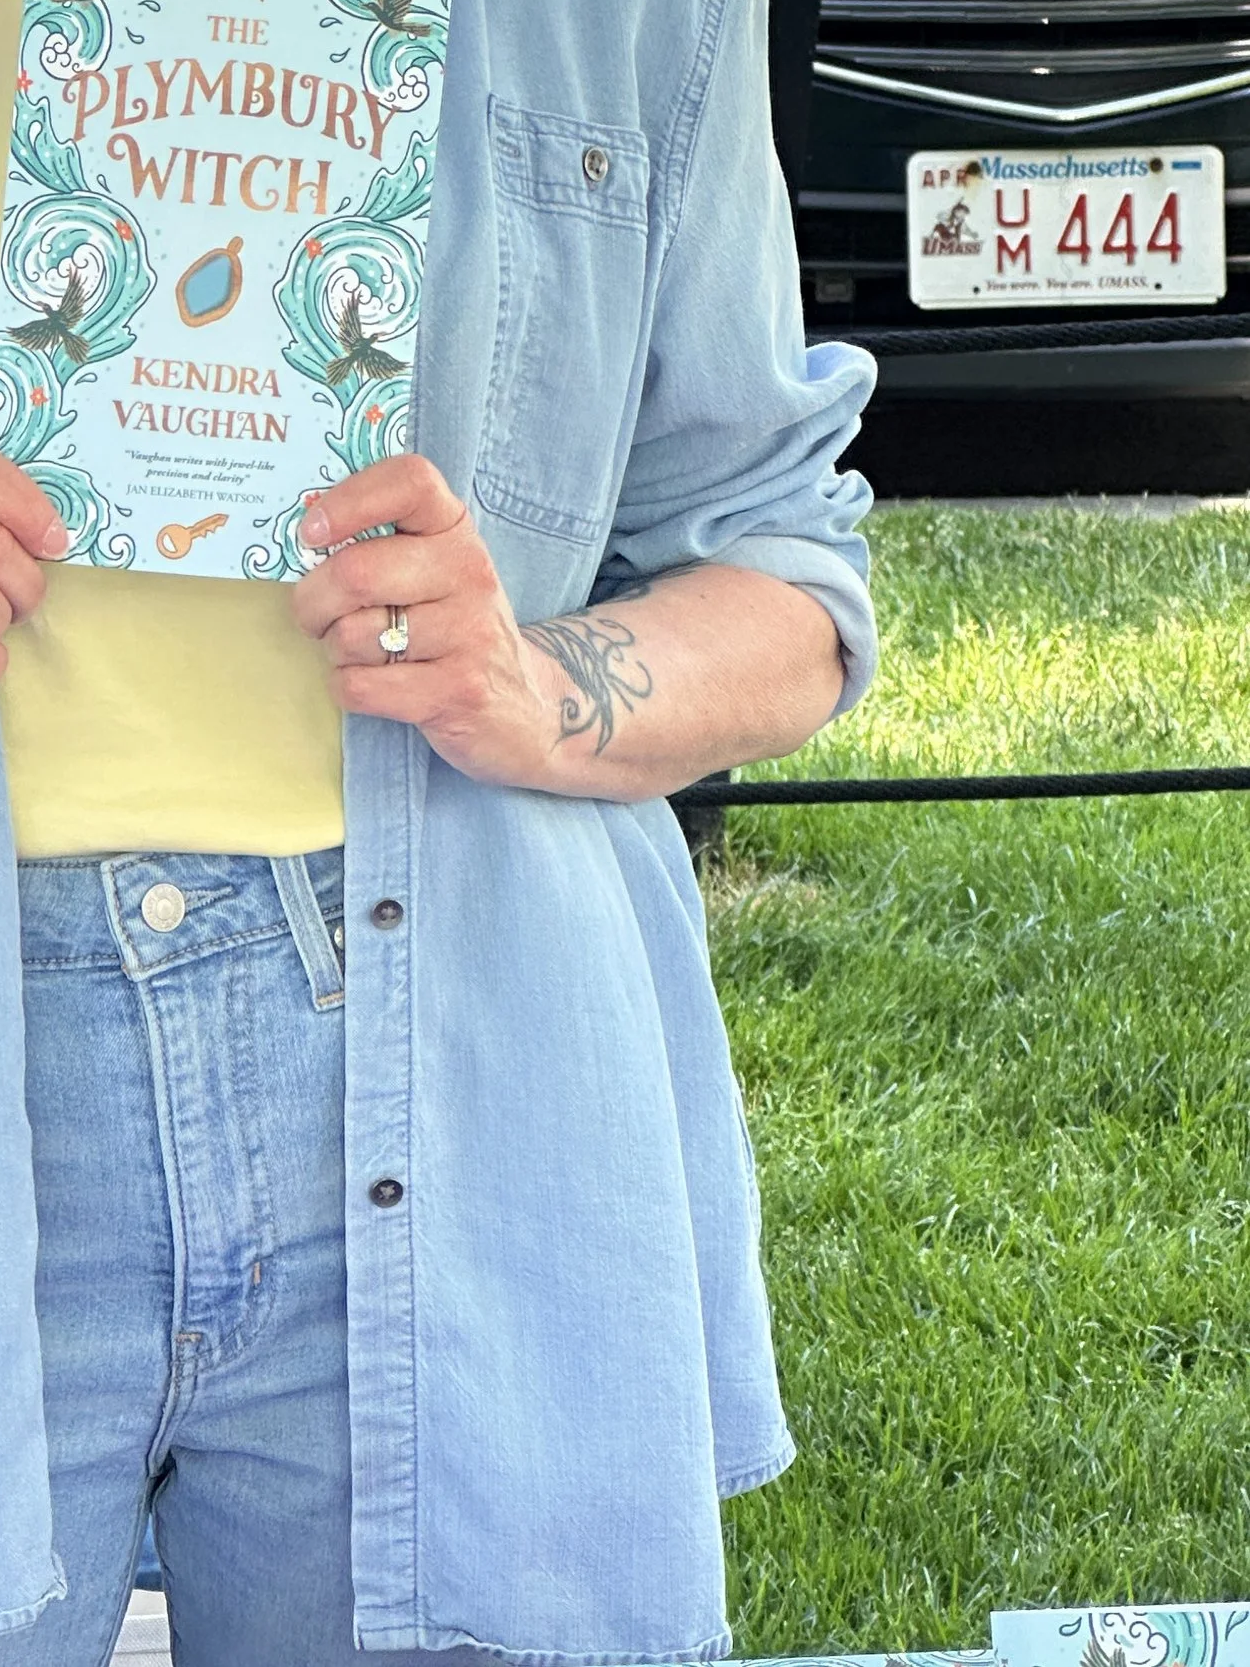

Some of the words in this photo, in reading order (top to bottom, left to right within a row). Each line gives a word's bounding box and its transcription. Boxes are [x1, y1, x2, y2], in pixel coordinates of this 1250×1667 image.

[207, 15, 269, 46] THE
[62, 58, 402, 162] PLYMBURY
[106, 133, 332, 215] WITCH
[980, 155, 1149, 180] Massachusetts
[1056, 192, 1182, 265] 444
[131, 356, 282, 398] KENDRA
[112, 400, 292, 443] VAUGHAN
[145, 468, 189, 479] precision
[191, 470, 211, 481] and
[174, 455, 203, 466] writes
[205, 457, 227, 468] with
[227, 459, 275, 471] jewel-like
[126, 484, 148, 496] JAN
[150, 486, 214, 501] ELIZABETH
[216, 491, 266, 504] WATSON
